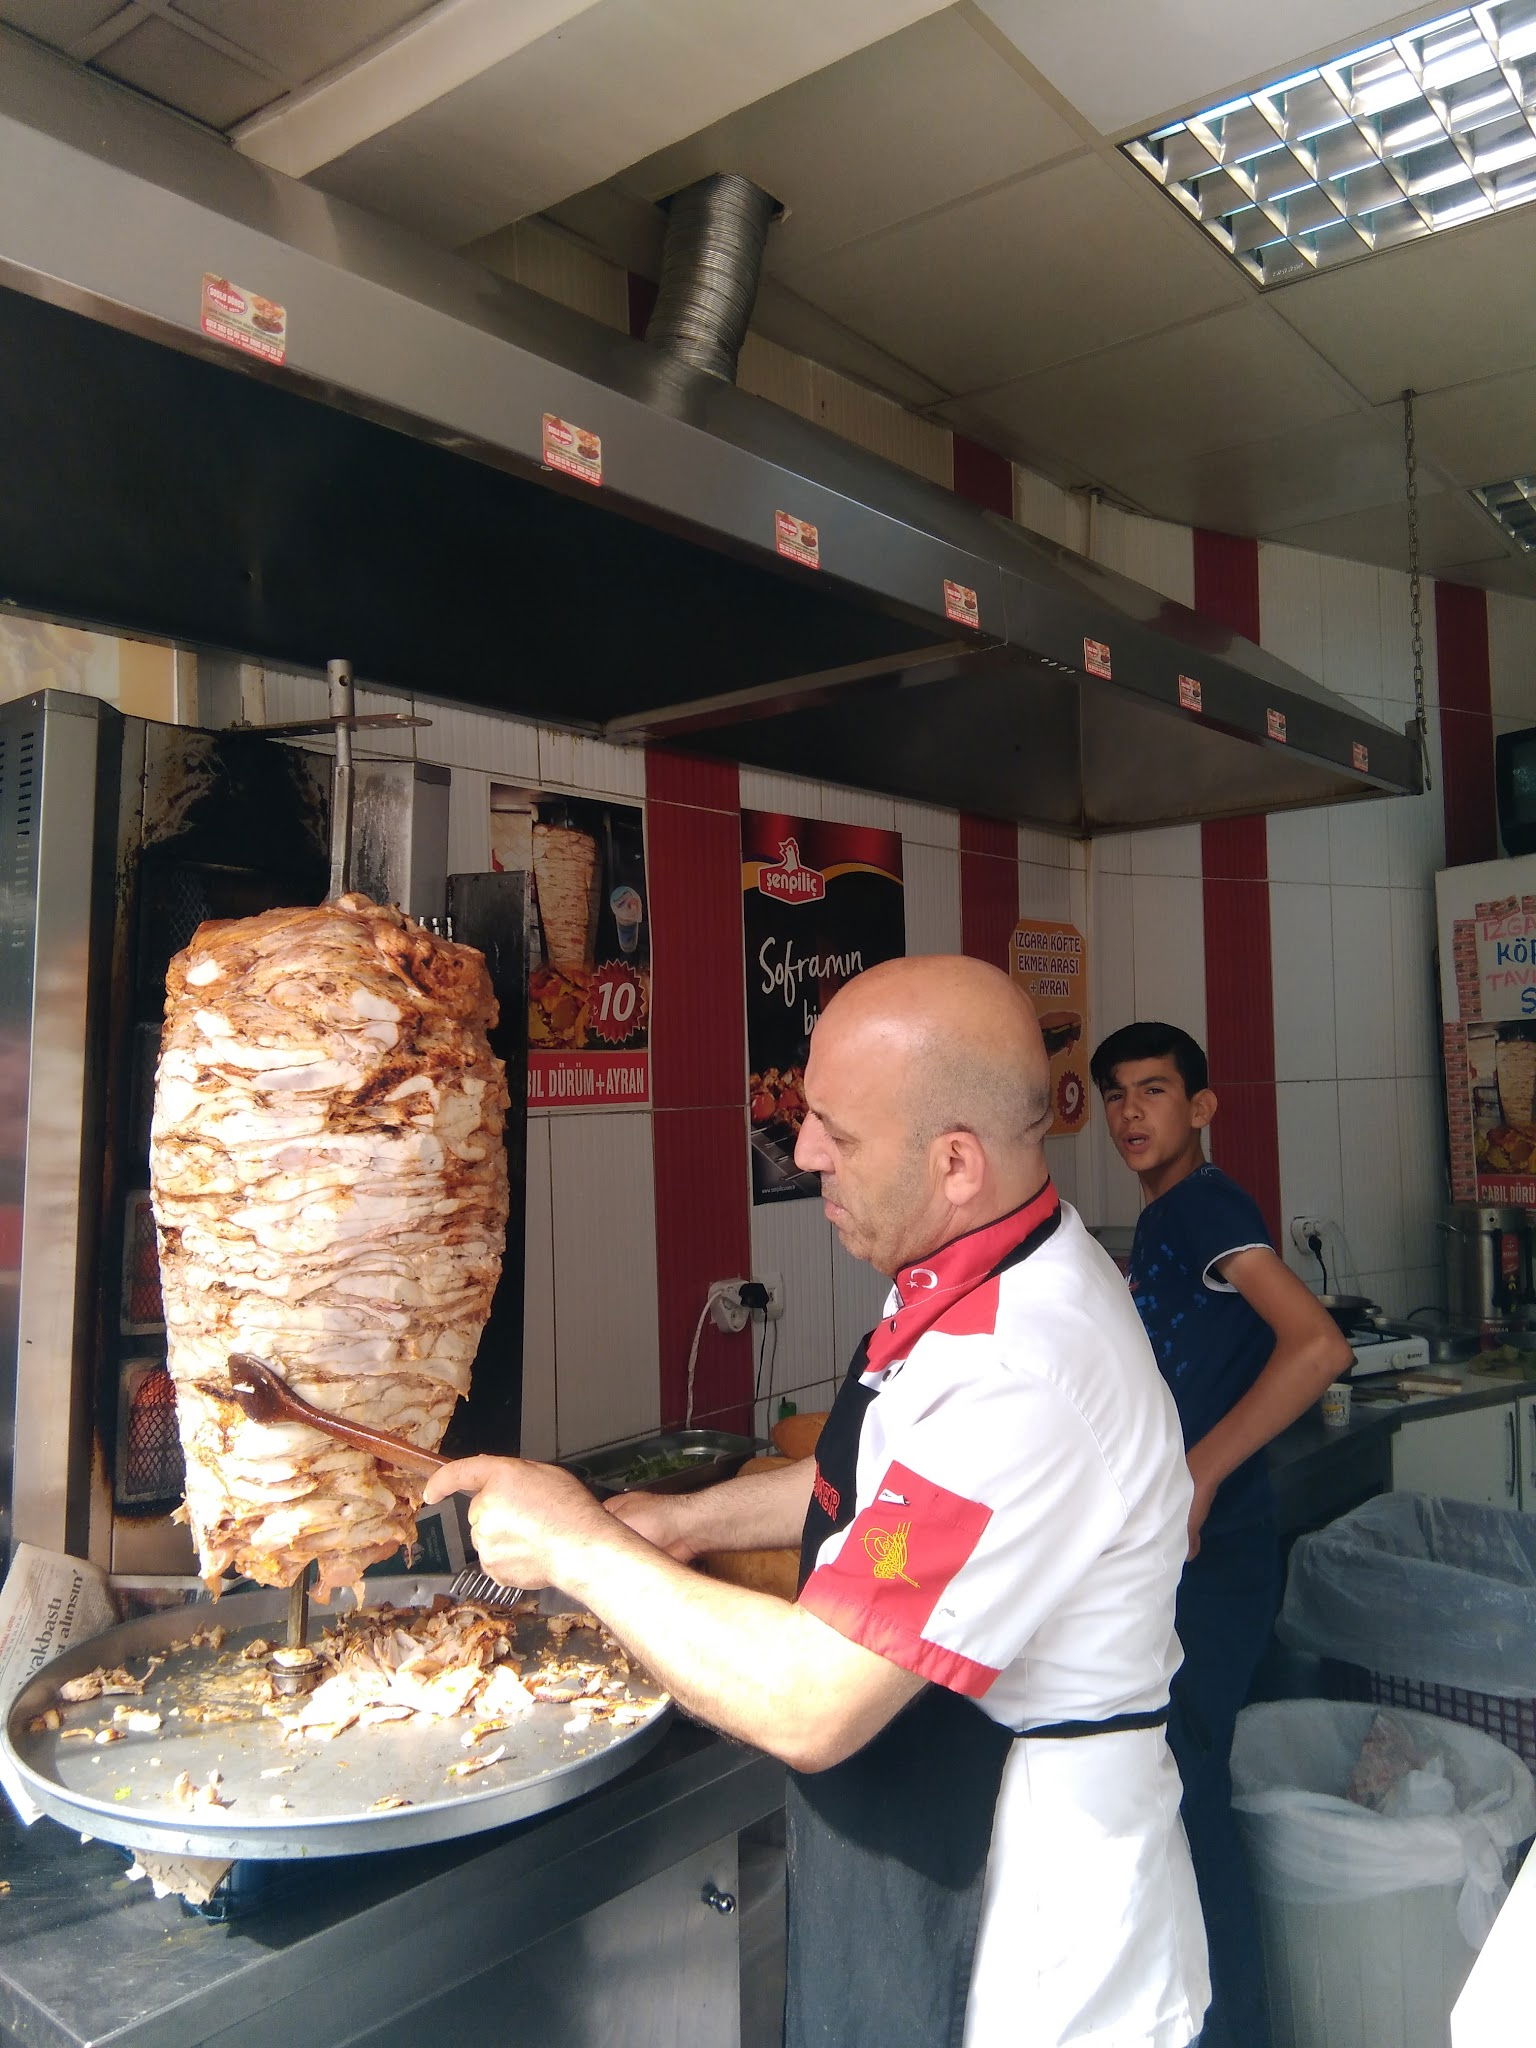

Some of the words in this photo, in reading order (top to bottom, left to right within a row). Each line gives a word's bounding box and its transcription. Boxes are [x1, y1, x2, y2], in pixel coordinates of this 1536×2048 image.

[1015, 931, 1048, 950] IZGARA
[1050, 930, 1081, 953] KÖFTE
[759, 936, 864, 1008] Soframın
[1018, 955, 1049, 973] EKMEK
[1050, 957, 1079, 975] ARASI
[598, 981, 636, 1022] 10
[1039, 979, 1069, 996] AYRAN
[1065, 1081, 1080, 1115] 9
